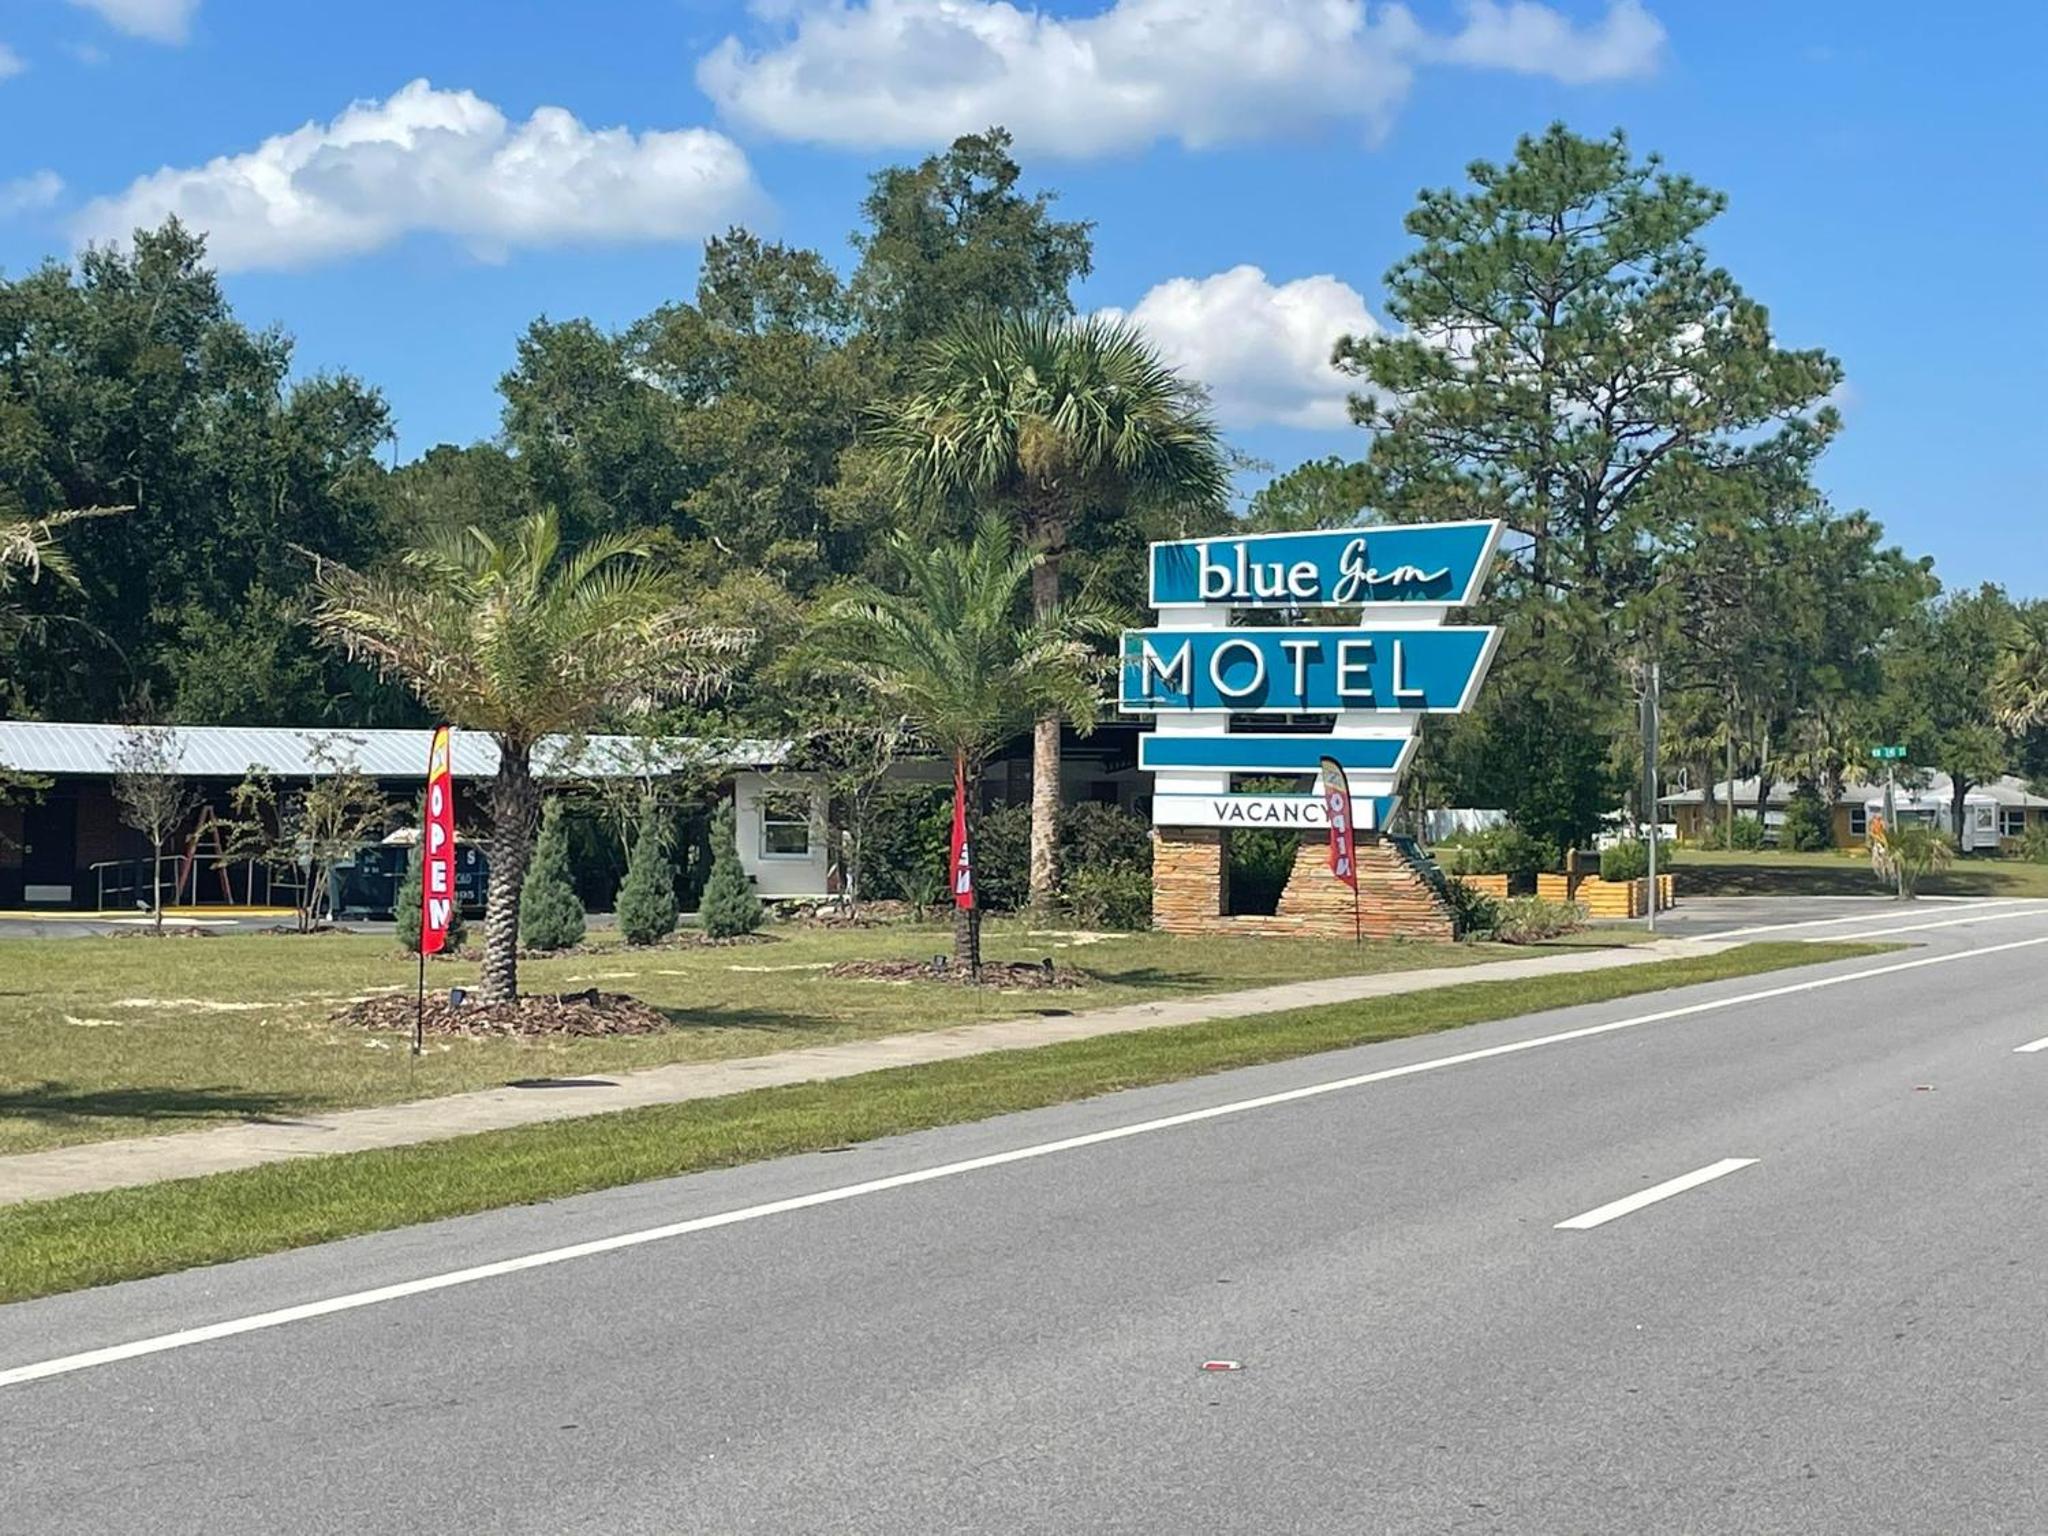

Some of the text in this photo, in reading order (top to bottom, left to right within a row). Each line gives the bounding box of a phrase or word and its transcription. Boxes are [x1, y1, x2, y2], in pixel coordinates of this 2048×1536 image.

[1197, 538, 1448, 601] blue Gem
[1142, 638, 1425, 697] MOTEL
[429, 784, 450, 930] OPEN
